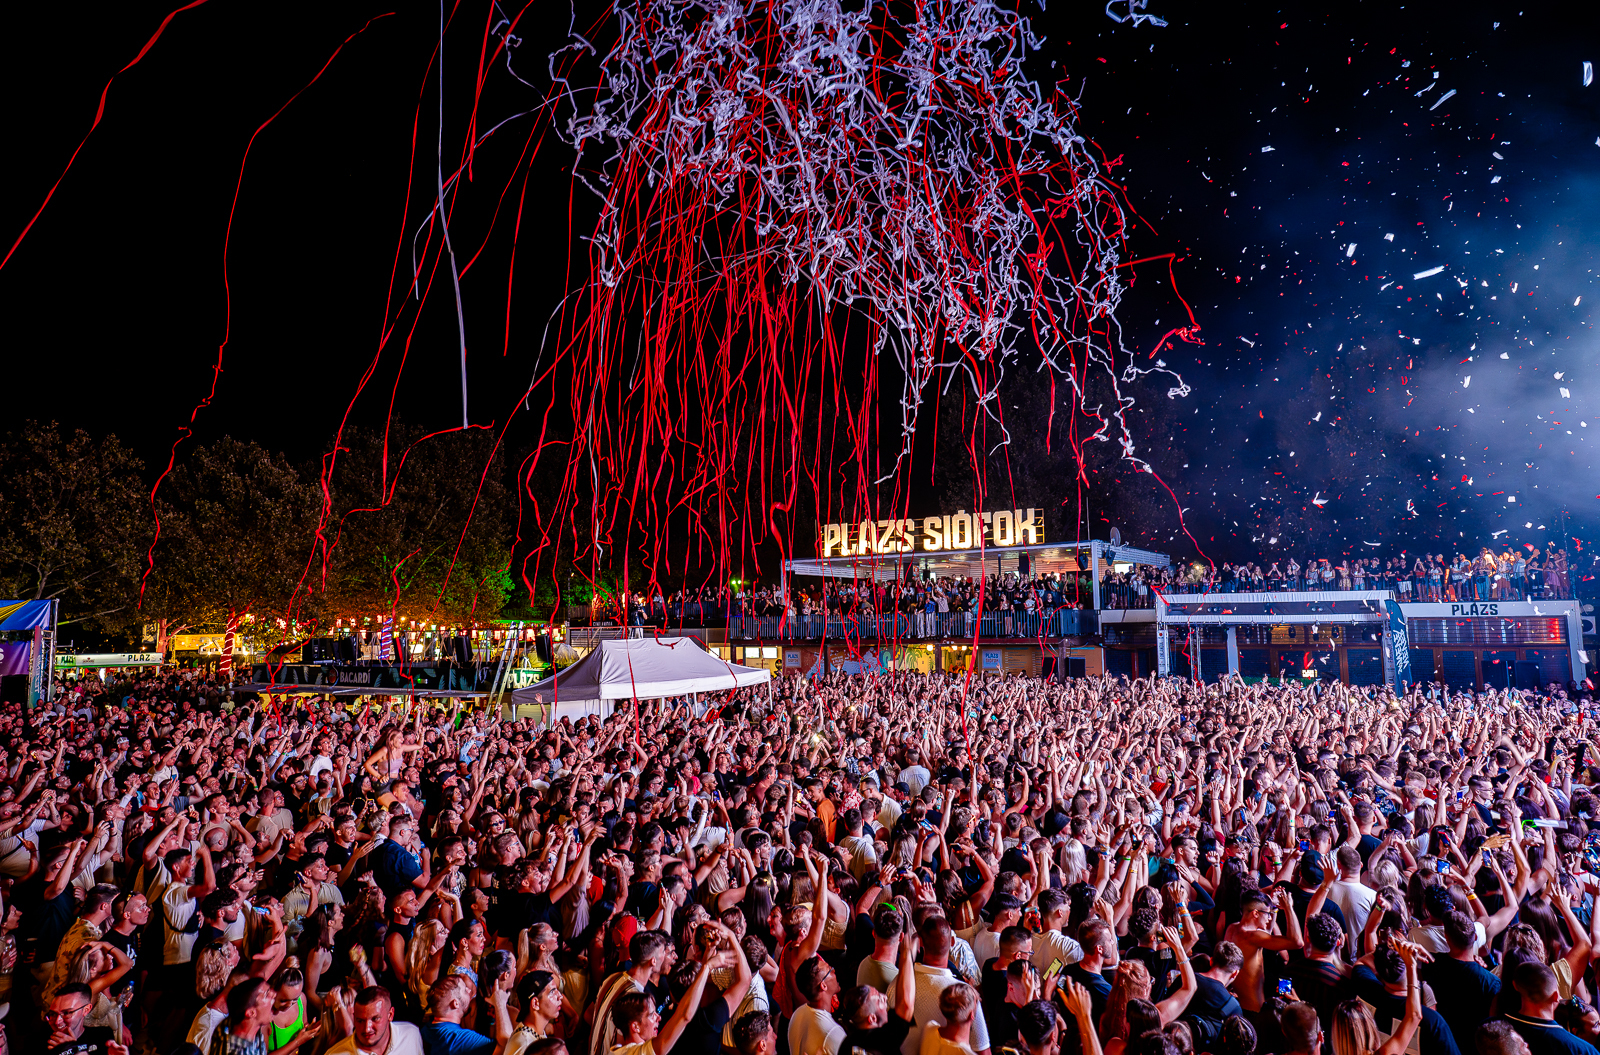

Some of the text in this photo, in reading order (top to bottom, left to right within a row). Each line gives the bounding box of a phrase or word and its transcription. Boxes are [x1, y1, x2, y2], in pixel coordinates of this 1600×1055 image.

[923, 508, 1037, 550] SIÓFOK
[1451, 602, 1498, 615] PLÁZS
[340, 668, 371, 684] BACARDÍ
